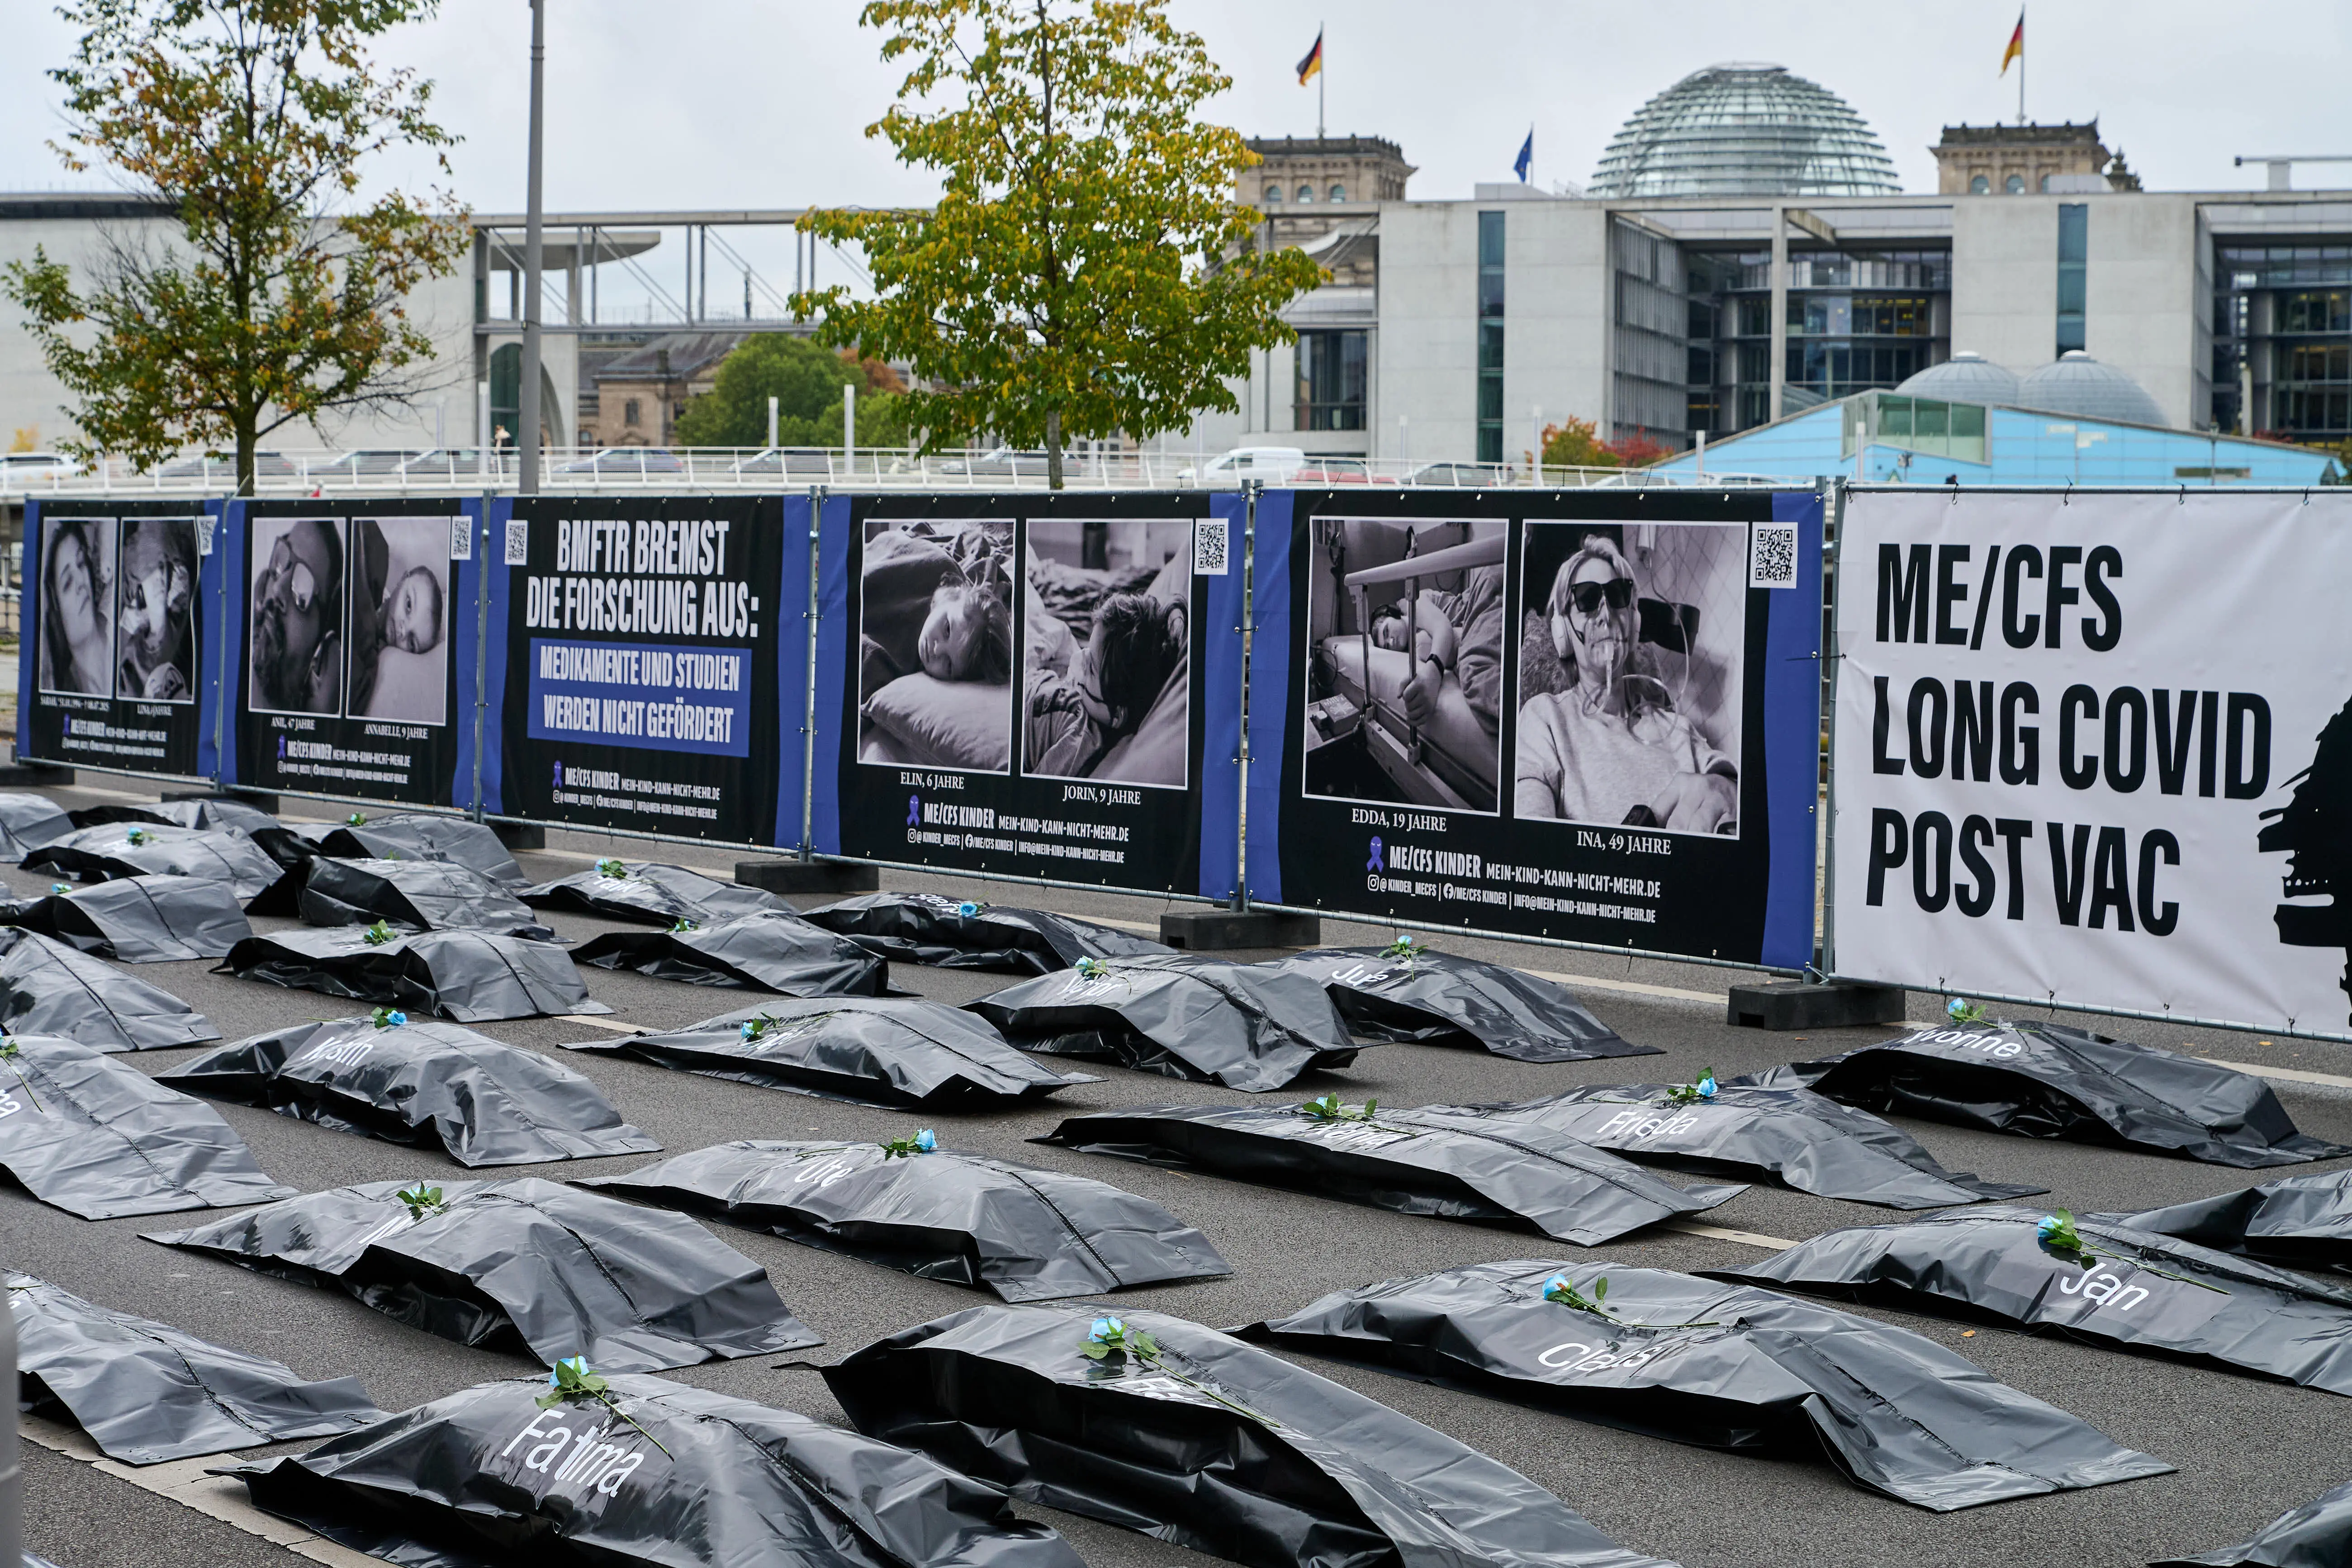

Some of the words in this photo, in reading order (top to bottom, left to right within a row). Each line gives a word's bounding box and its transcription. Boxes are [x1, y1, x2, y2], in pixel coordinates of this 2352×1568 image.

[557, 520, 630, 573] BMFTR
[634, 520, 729, 575] BREMST
[526, 576, 561, 628] DIE
[564, 578, 697, 635] FORSCHUNG
[701, 581, 759, 637] AUS:
[1876, 543, 2123, 652] ME/CFS
[540, 645, 639, 685] MEDIKAMENTE
[641, 651, 673, 687] UND
[676, 653, 740, 691] STUDIEN
[295, 718, 316, 731] JAHRE
[406, 727, 428, 740] JAHRE
[544, 694, 599, 732] WERDEN
[602, 699, 645, 736] NICHT
[647, 696, 734, 743] GEFÖRDERT
[287, 739, 309, 758] ME/CFS
[309, 741, 332, 760] KINDER
[1873, 676, 2039, 786] LONG
[2059, 684, 2271, 800] COVID
[565, 767, 590, 787] ME/CFS
[591, 770, 620, 791] KINDER
[621, 778, 720, 801] MEIN-KIND-KANN-NICHT-MEHR.DE
[901, 772, 925, 788] ELIN,
[926, 774, 933, 786] 6
[933, 774, 964, 791] JAHRE
[1063, 785, 1098, 803] JORIN,
[1100, 788, 1106, 802] 9
[1107, 789, 1141, 805] JAHRE
[924, 802, 958, 825] ME/CFS
[959, 805, 994, 829] KINDER
[999, 815, 1129, 842] MEIN-KIND-KANN-NICHT-MEHR.DE
[1352, 808, 1390, 828] EDDA,
[1393, 813, 1405, 828] 19
[1406, 814, 1447, 832] JAHRE
[995, 839, 1013, 852] KINDER
[1019, 841, 1124, 863] INFO@MEIN-KIND-KANN-NICHT-MEHR.DE
[1577, 831, 1606, 851] INA,
[1609, 834, 1624, 851] 49
[1626, 835, 1672, 856] JAHRE
[1389, 844, 1433, 873] ME/CFS
[1435, 849, 1481, 879] KINDER
[1486, 862, 1661, 899] MEIN-KIND-KANN-NICHT-MEHR.DE
[1866, 807, 2033, 921] POST
[2046, 822, 2180, 937] VAC
[1482, 889, 1507, 905] KINDER
[1514, 893, 1656, 923] INFO@MEIN-KIND-KANN-NICHT-MEHR.DE
[1596, 1111, 1698, 1139] Frieda
[794, 1158, 853, 1187] Ute
[2060, 1263, 2149, 1311] Jan
[502, 1409, 645, 1498] Fatima
